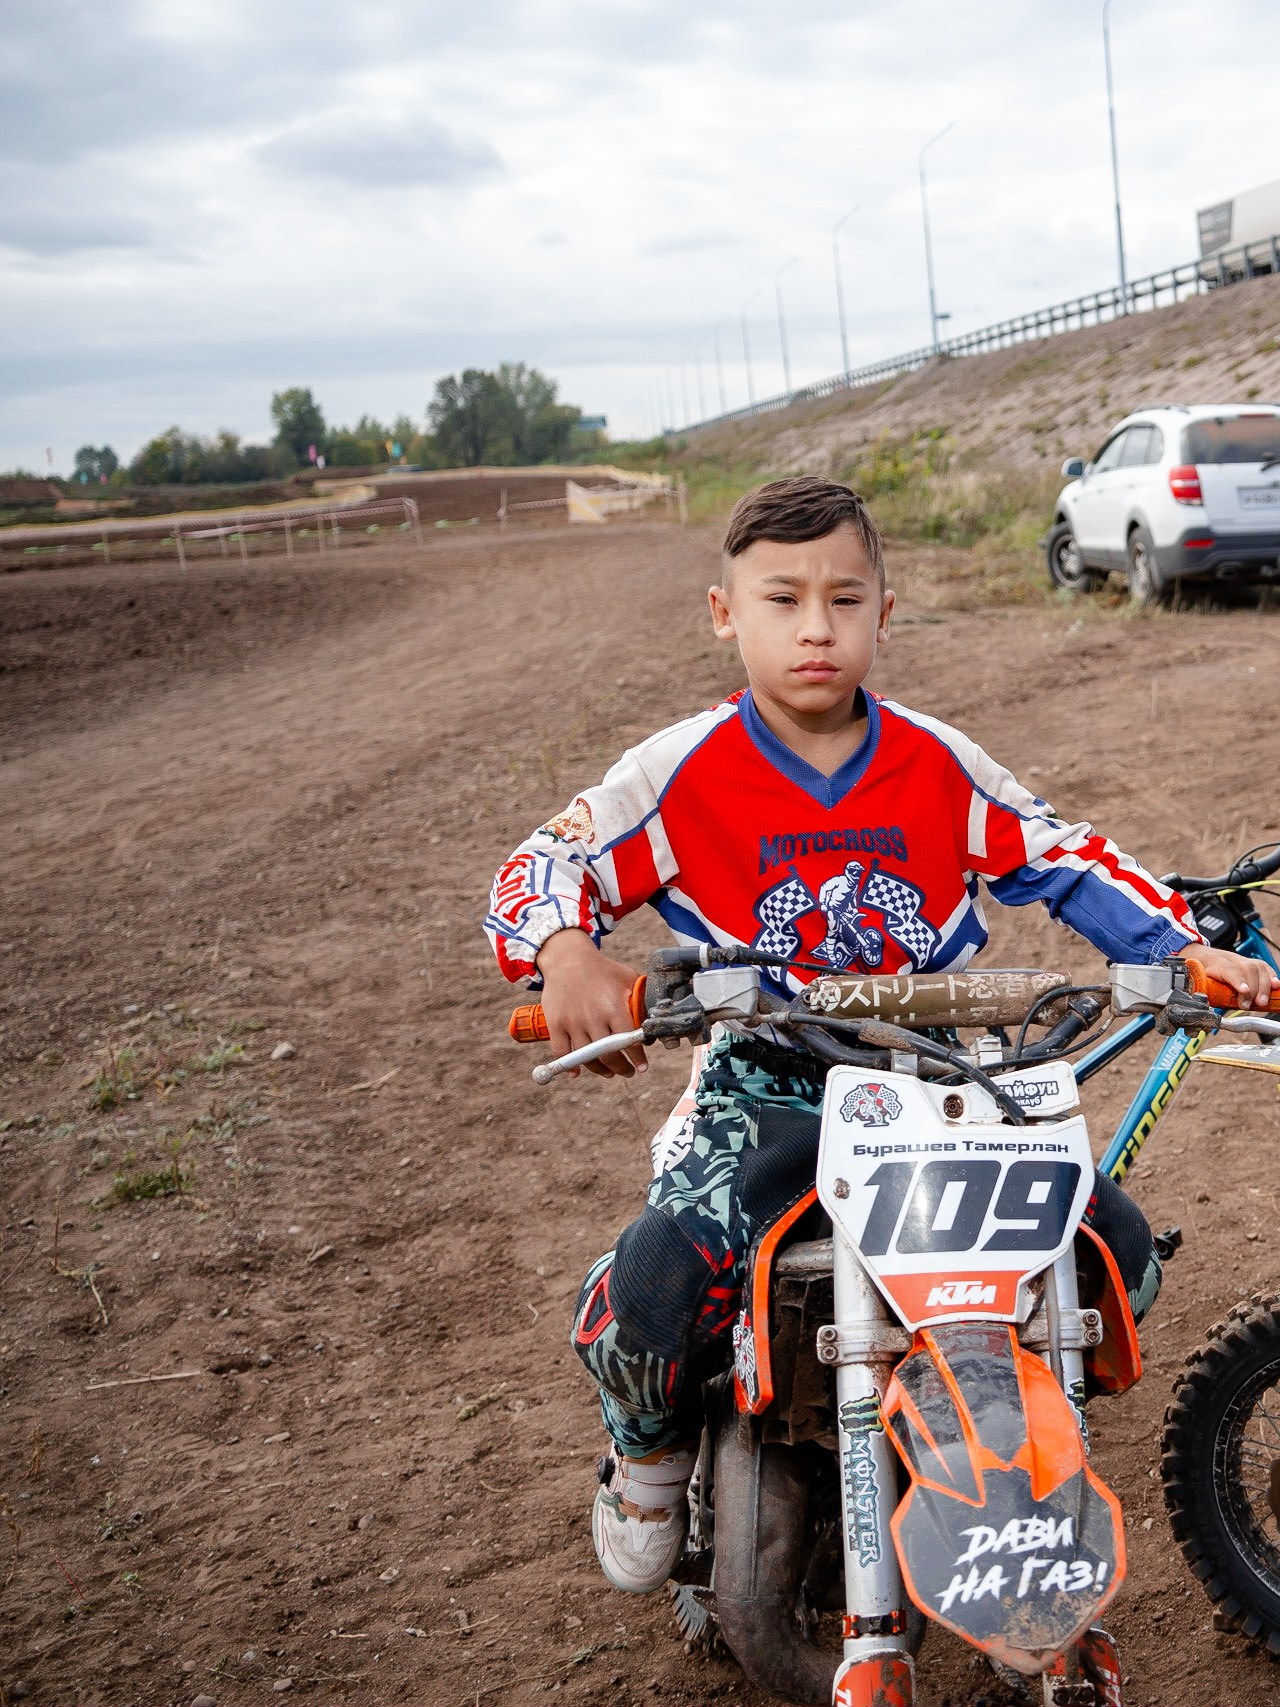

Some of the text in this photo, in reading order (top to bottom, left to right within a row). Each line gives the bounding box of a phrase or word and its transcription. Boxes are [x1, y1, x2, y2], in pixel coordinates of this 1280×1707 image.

[758, 825, 908, 875] MOTOCROSS
[840, 973, 1027, 1009] ストリート忍者
[998, 1080, 1059, 1098] АЙФУН
[1015, 1096, 1042, 1107] оклуб
[853, 1140, 1069, 1157] Бурашев Тамерлан
[859, 1160, 1082, 1257] 109
[925, 1280, 997, 1307] KTM
[853, 1438, 880, 1567] MONSTER
[954, 1513, 1075, 1565] ДАВИ
[935, 1556, 1108, 1613] НА ГАЗ!
